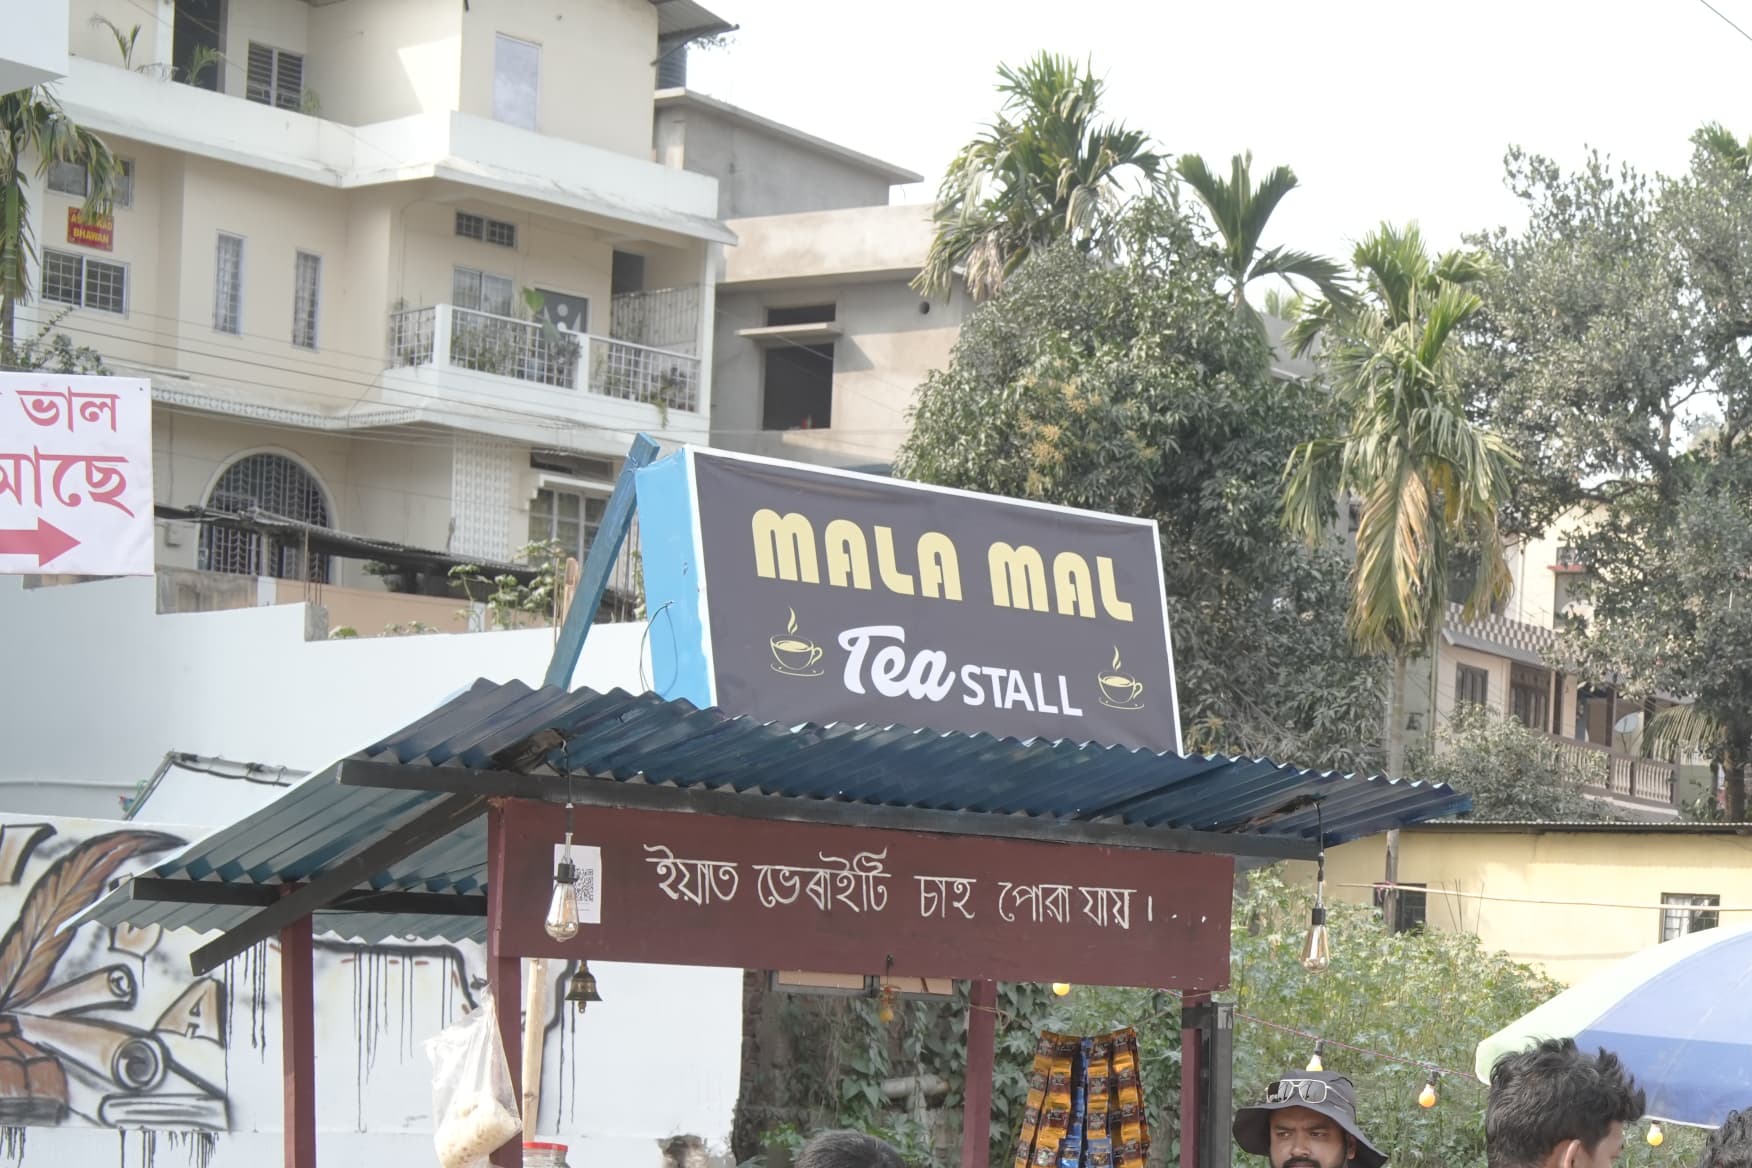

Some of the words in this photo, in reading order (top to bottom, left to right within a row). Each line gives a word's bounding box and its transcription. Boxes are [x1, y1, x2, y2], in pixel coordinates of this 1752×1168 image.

[16, 385, 120, 433] ভাল
[752, 508, 963, 601] MALA
[987, 540, 1134, 622] MAL
[837, 624, 956, 702] Tea
[961, 663, 1083, 717] STALL
[643, 843, 739, 907] ইয়াত
[752, 847, 892, 912] ভেৰাইটি
[913, 875, 977, 918] চাহ
[998, 881, 1073, 923] পোৱা
